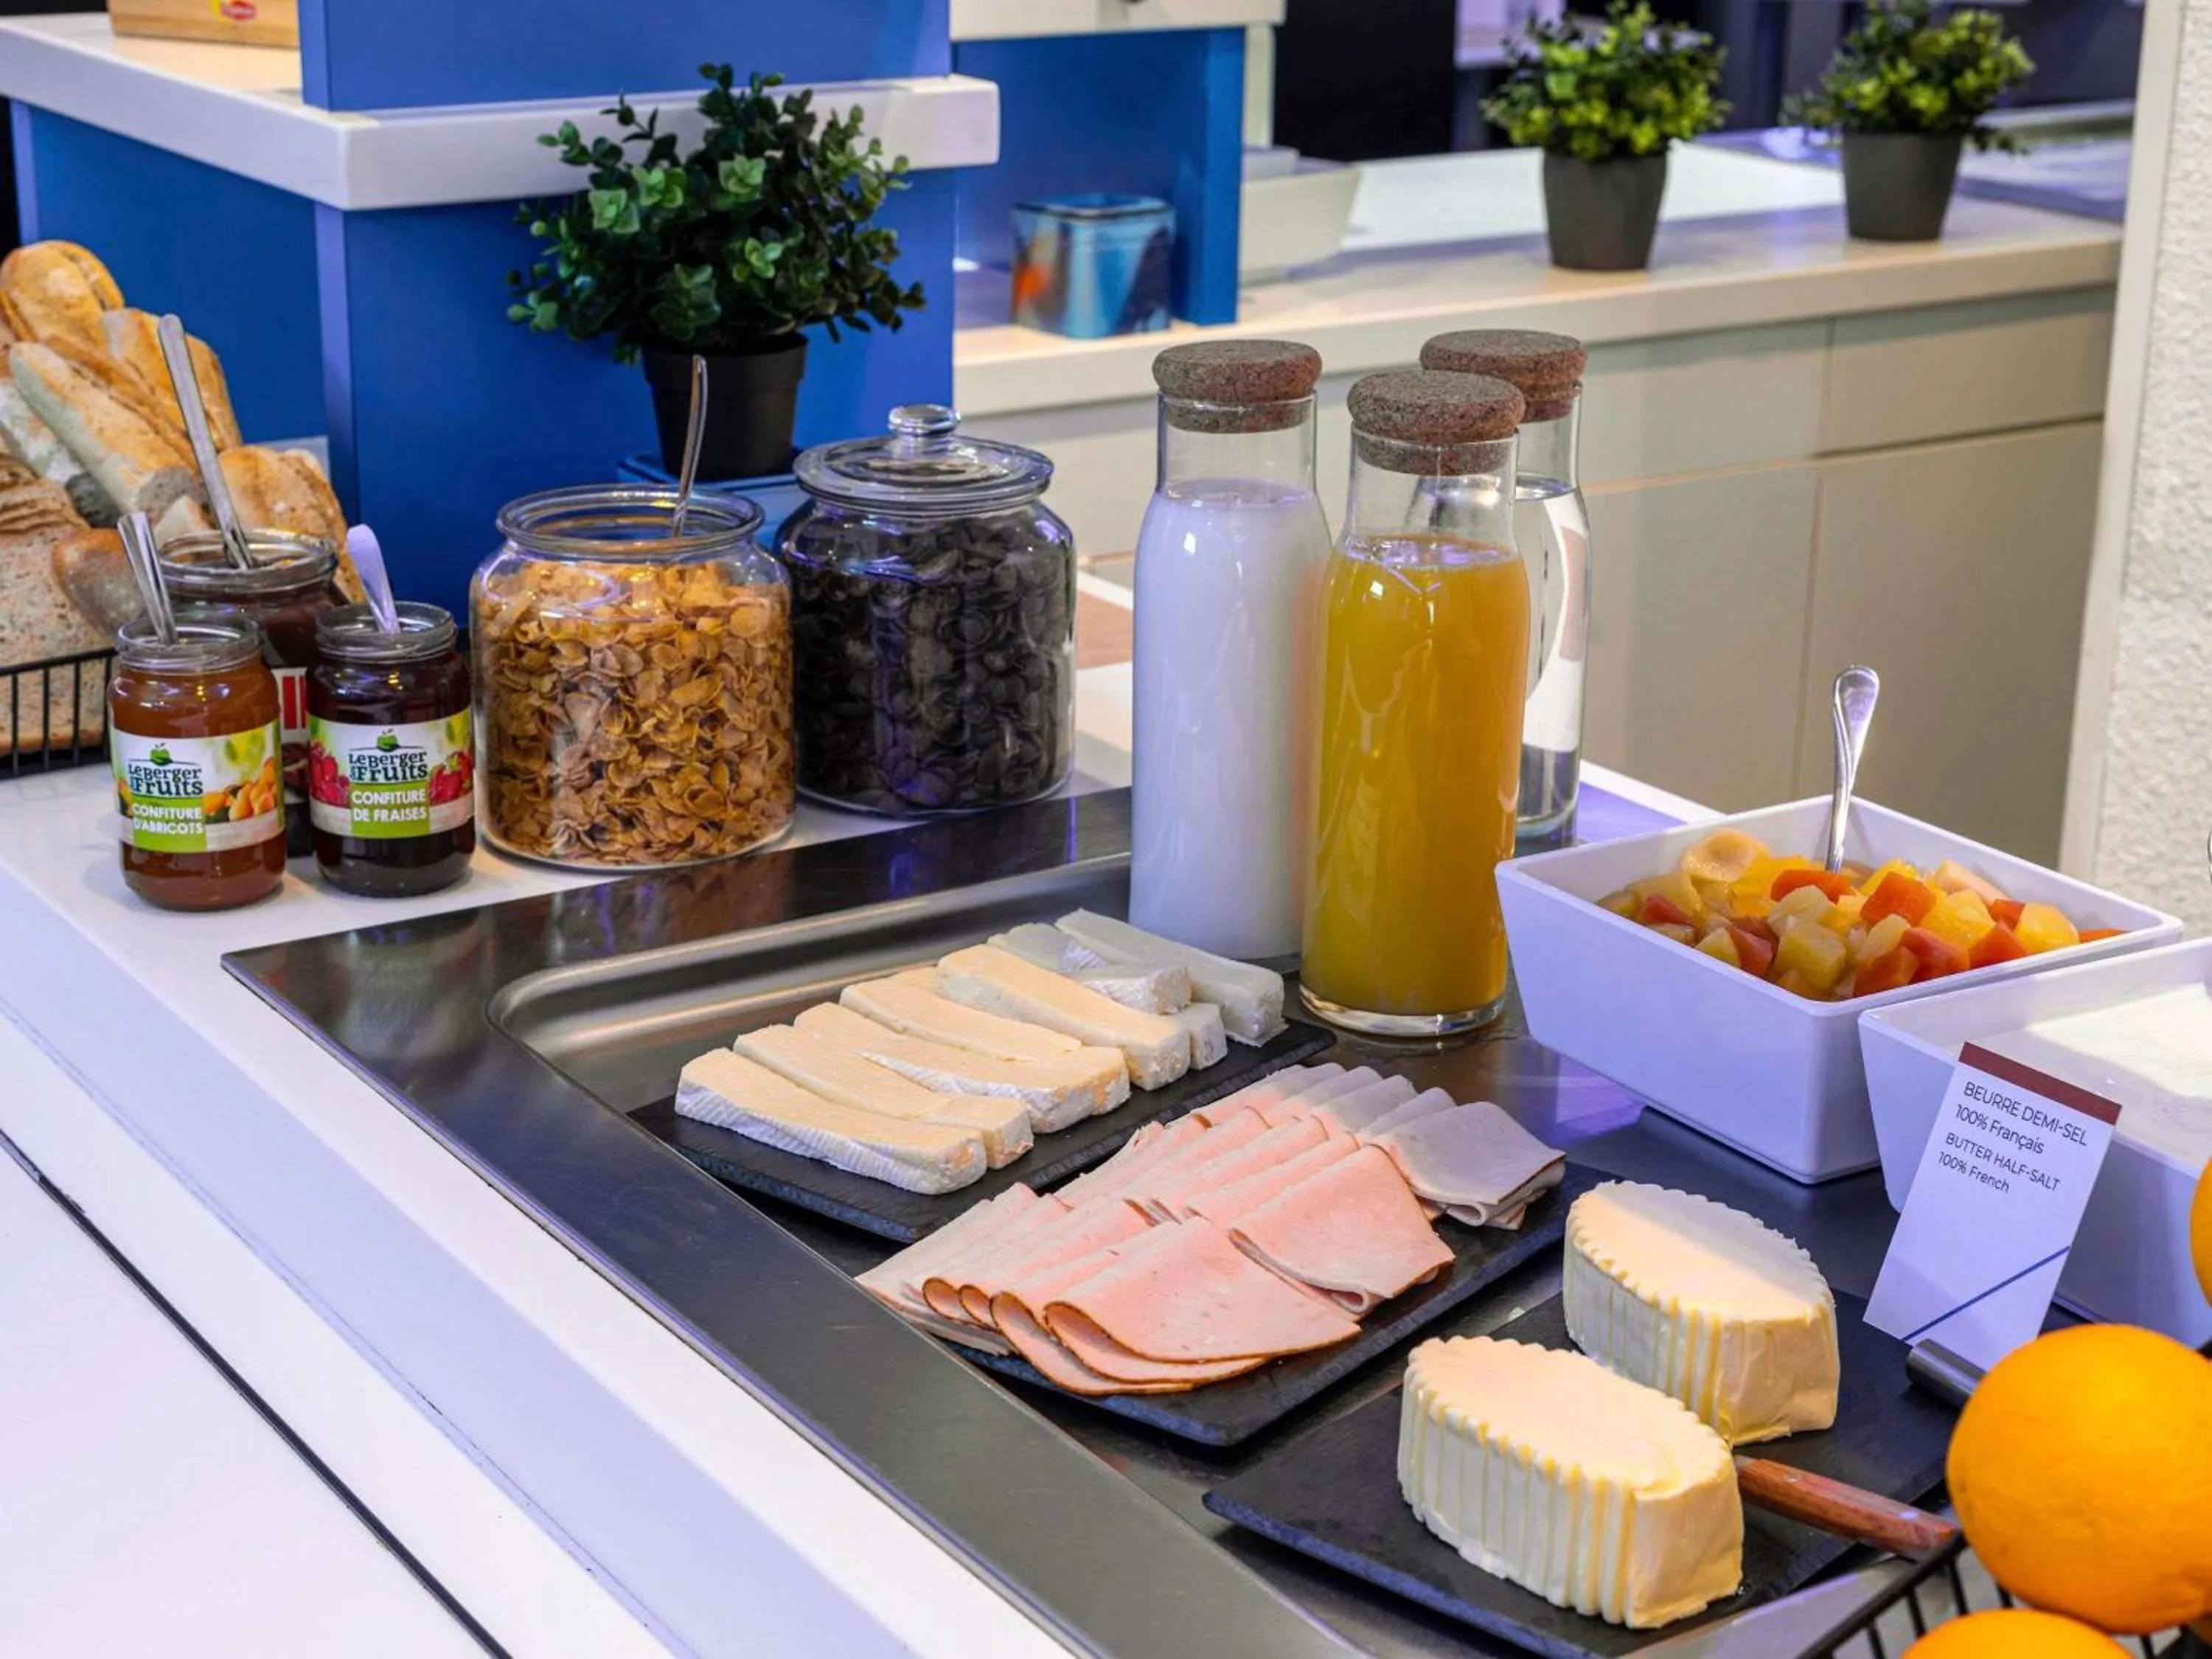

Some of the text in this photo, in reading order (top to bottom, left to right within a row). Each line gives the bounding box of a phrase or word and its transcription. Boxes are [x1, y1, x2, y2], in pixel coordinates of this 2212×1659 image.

[133, 802, 202, 821] CONFITURE
[352, 788, 425, 805] CONFITURE
[133, 816, 204, 835] D'ABRICOTS
[354, 806, 426, 824] DE FRAISES
[1956, 1104, 2045, 1155] 100% Français
[1964, 1082, 2087, 1147] BEURRE DEMI-SEL
[1938, 1151, 2010, 1193] 100% French
[1946, 1132, 2062, 1192] BUTTER HALF-SALT
